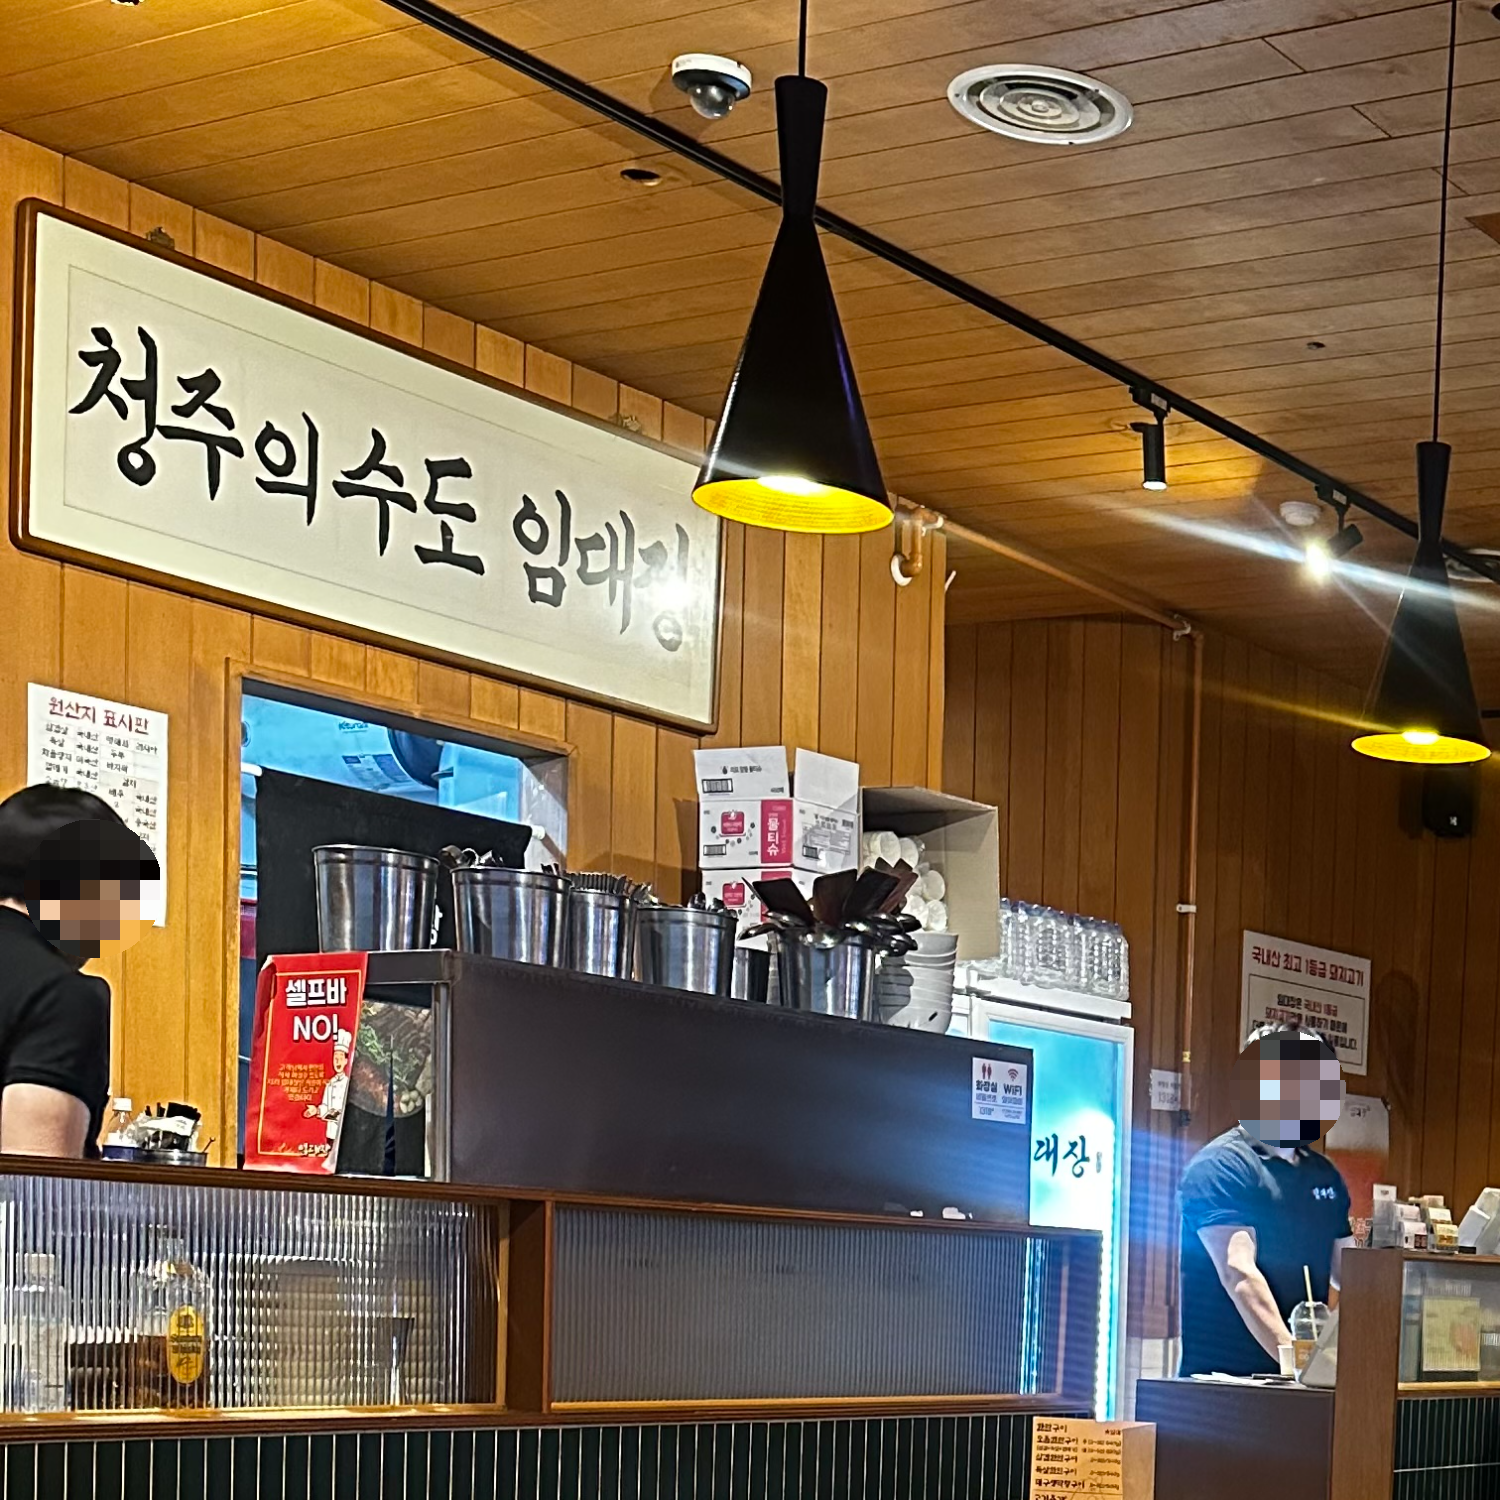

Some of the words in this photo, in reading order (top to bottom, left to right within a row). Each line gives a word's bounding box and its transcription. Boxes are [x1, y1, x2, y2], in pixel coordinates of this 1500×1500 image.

[333, 428, 486, 575] 수도
[512, 489, 693, 652] 임대장
[48, 696, 97, 724] 원산지
[103, 708, 149, 735] 표시판
[767, 818, 780, 856] 물티슈
[1251, 946, 1281, 968] 국내산
[1283, 953, 1302, 973] 최고
[1329, 963, 1364, 987] 돼지고기
[285, 977, 347, 1007] 셀프바
[293, 1014, 338, 1042] NO!
[976, 1080, 998, 1094] 화장실
[1033, 1133, 1091, 1178] 대장
